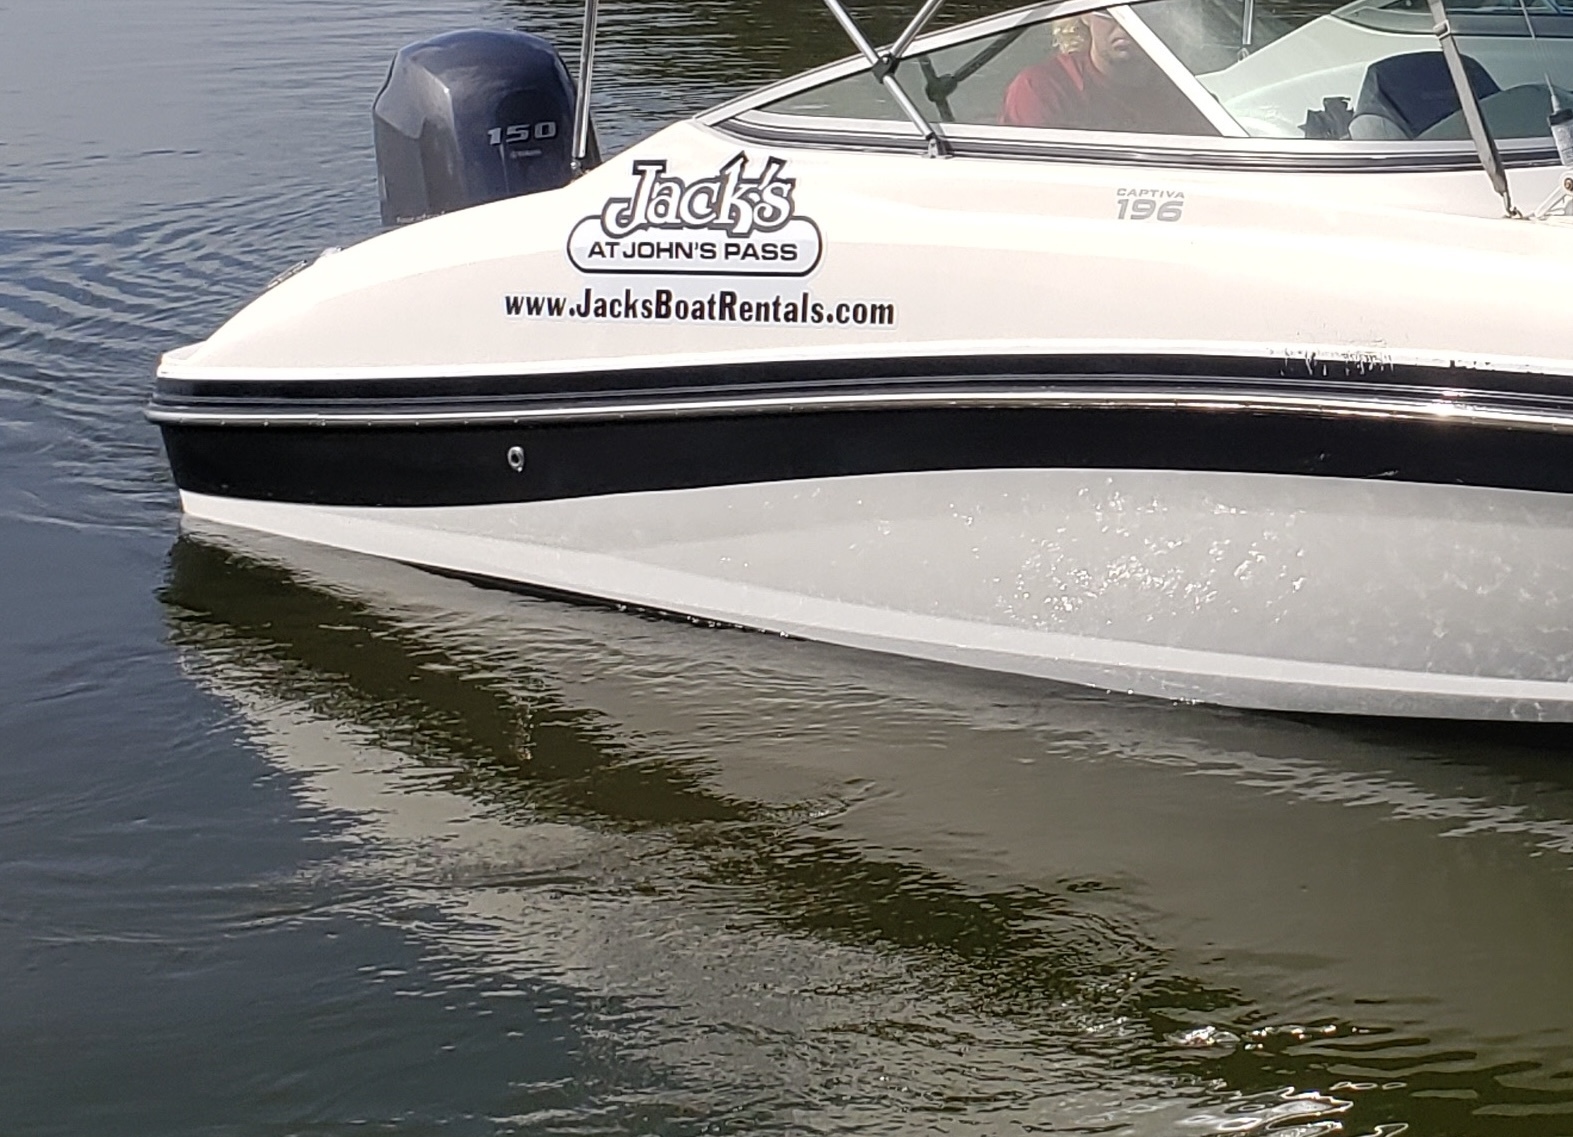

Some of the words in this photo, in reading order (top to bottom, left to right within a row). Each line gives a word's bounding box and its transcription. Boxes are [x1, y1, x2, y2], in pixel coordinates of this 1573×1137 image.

[488, 121, 556, 145] 150
[600, 150, 797, 239] Jack's
[1116, 187, 1185, 199] CAPTIVA
[1117, 198, 1184, 222] 196
[587, 242, 621, 260] AT
[622, 241, 718, 262] JOHN'S
[724, 243, 799, 262] PASS
[505, 288, 895, 325] www.JacksBoatRentals.com
